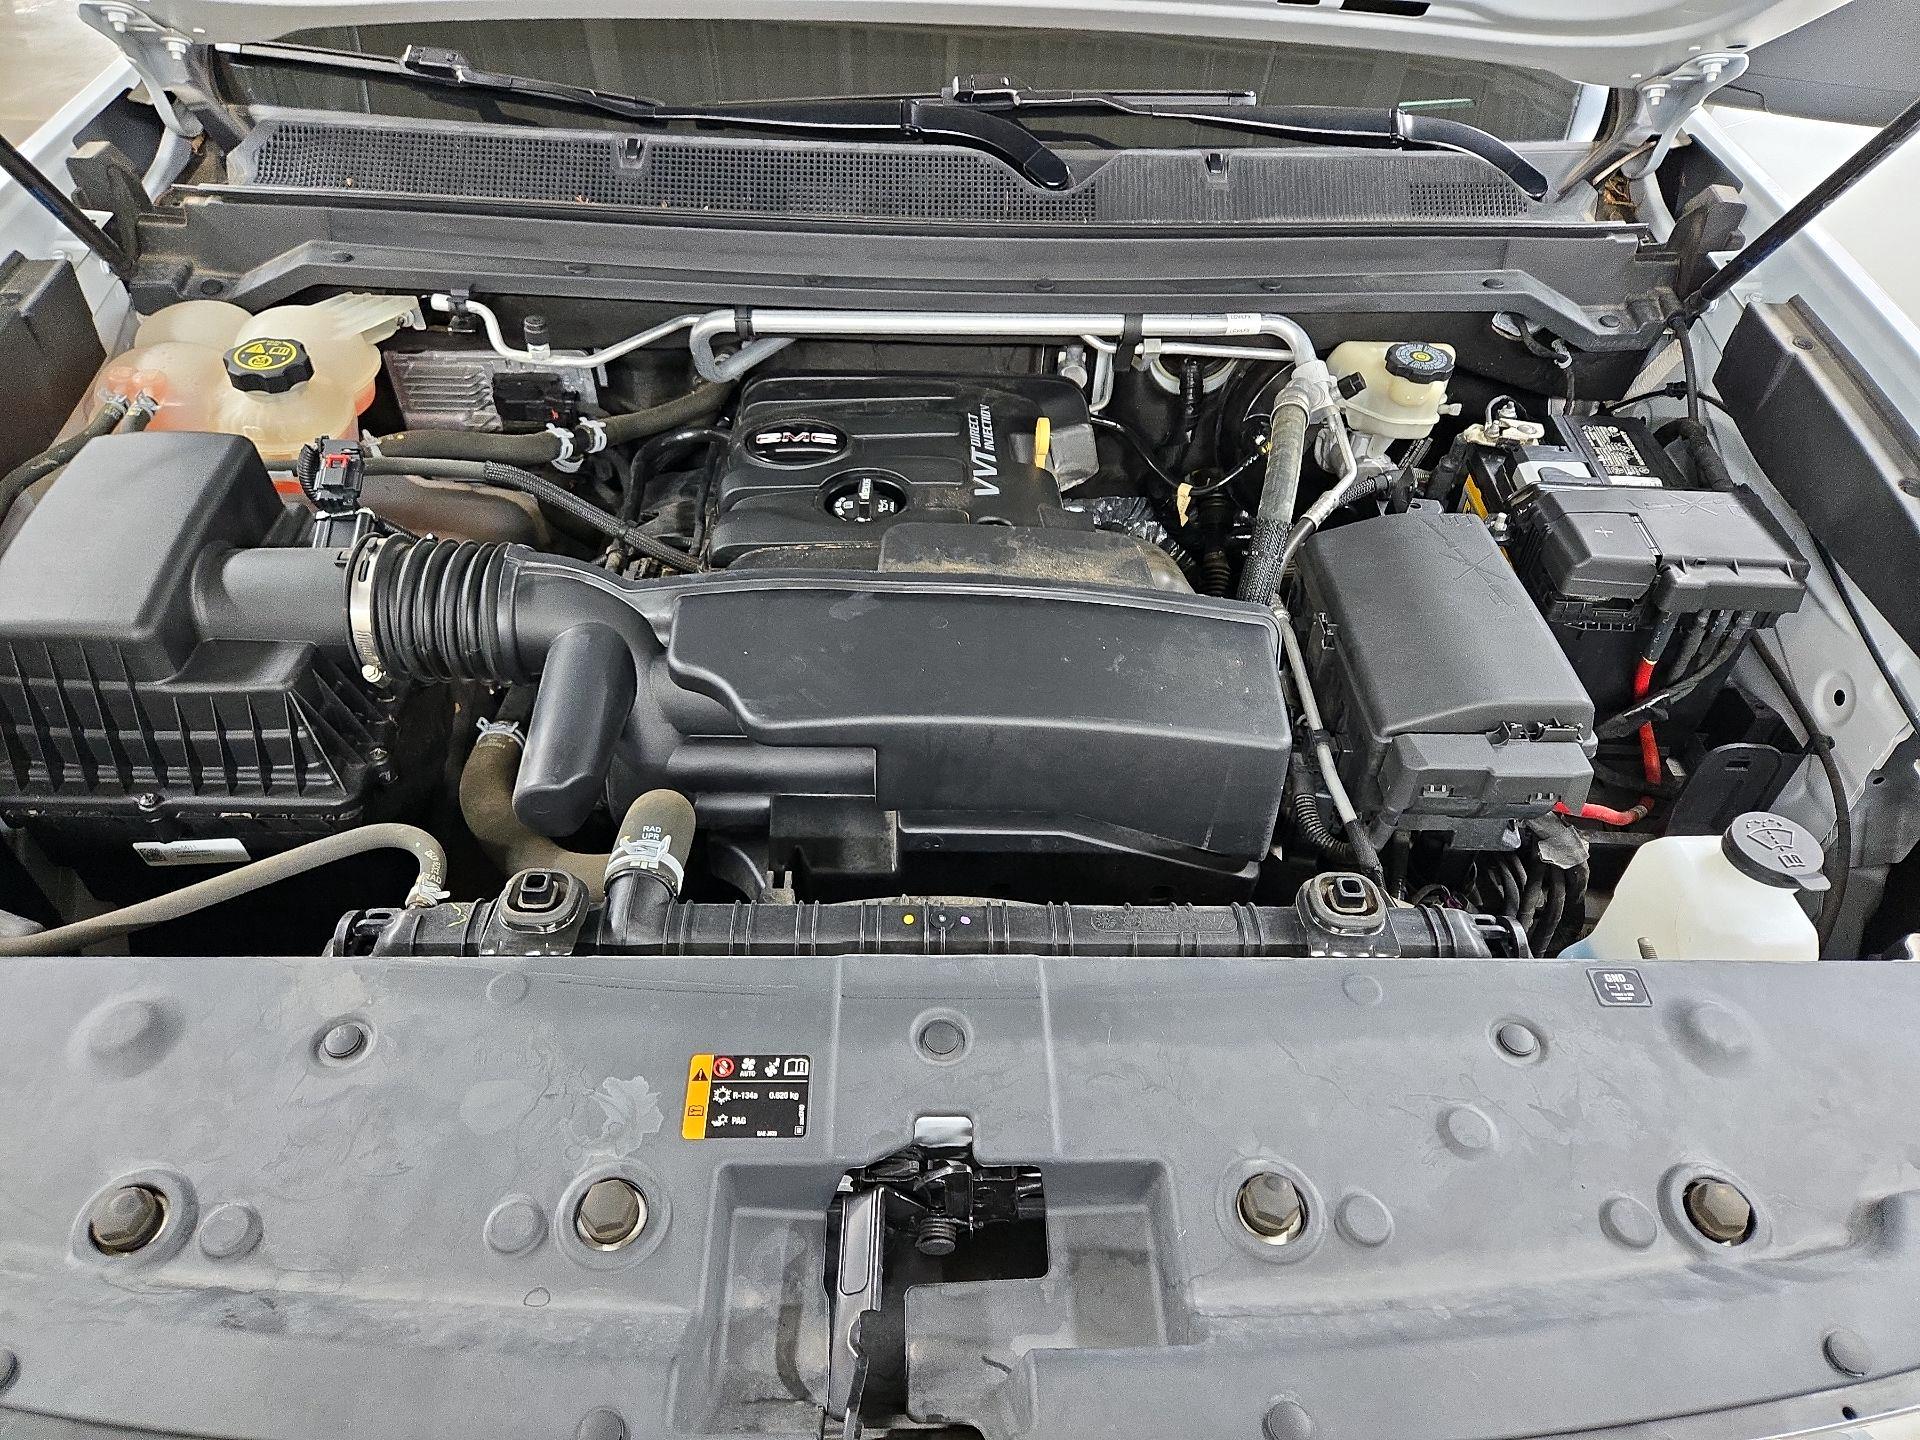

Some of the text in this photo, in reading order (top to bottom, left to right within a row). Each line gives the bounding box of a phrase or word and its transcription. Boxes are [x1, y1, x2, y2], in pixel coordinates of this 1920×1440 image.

[967, 412, 982, 448] DIRECT
[979, 403, 996, 452] INJECTION
[755, 431, 838, 445] GMC
[970, 445, 1000, 496] VVT
[642, 825, 662, 833] RAD
[641, 832, 660, 841] UPR
[1603, 973, 1627, 983] GND
[739, 1070, 757, 1078] AUTO
[732, 1091, 759, 1100] R-134a
[789, 1091, 800, 1101] kg
[731, 1116, 747, 1125] PAG
